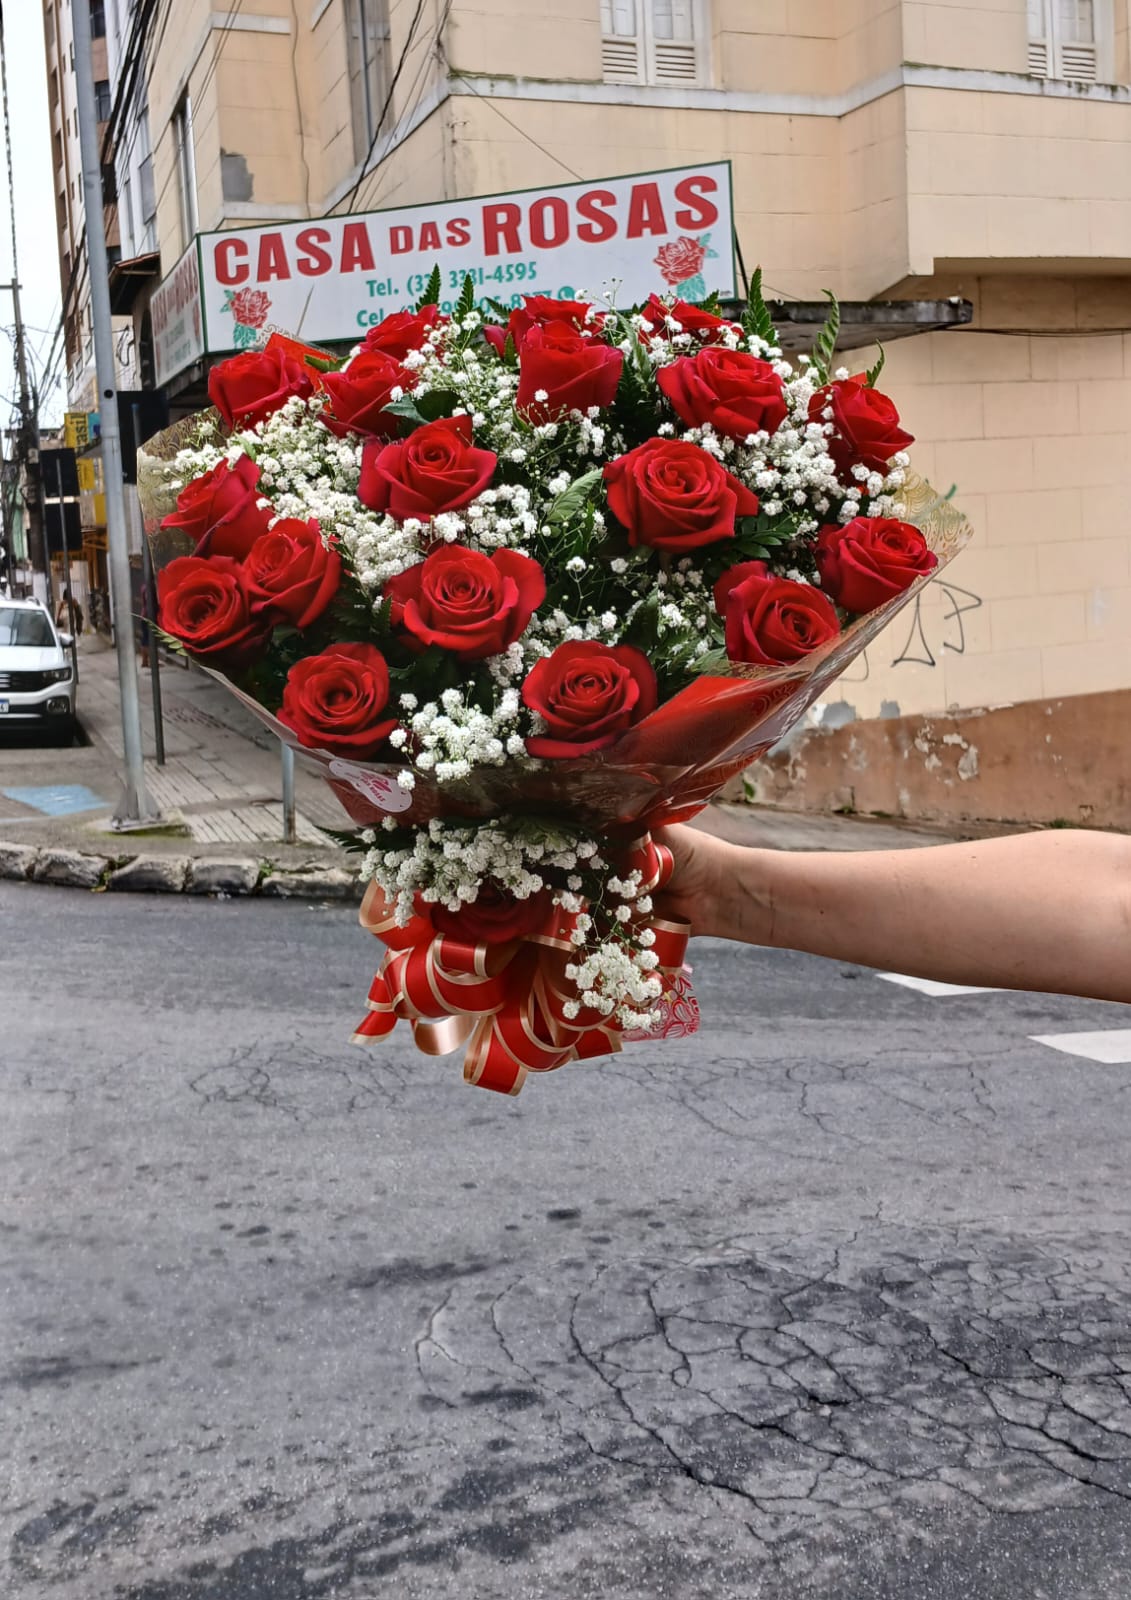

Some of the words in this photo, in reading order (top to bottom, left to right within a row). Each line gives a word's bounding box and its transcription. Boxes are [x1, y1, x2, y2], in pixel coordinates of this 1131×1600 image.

[214, 222, 376, 286] CASA
[389, 218, 471, 255] DAS
[482, 175, 719, 257] ROSAS
[365, 277, 399, 297] Tel.
